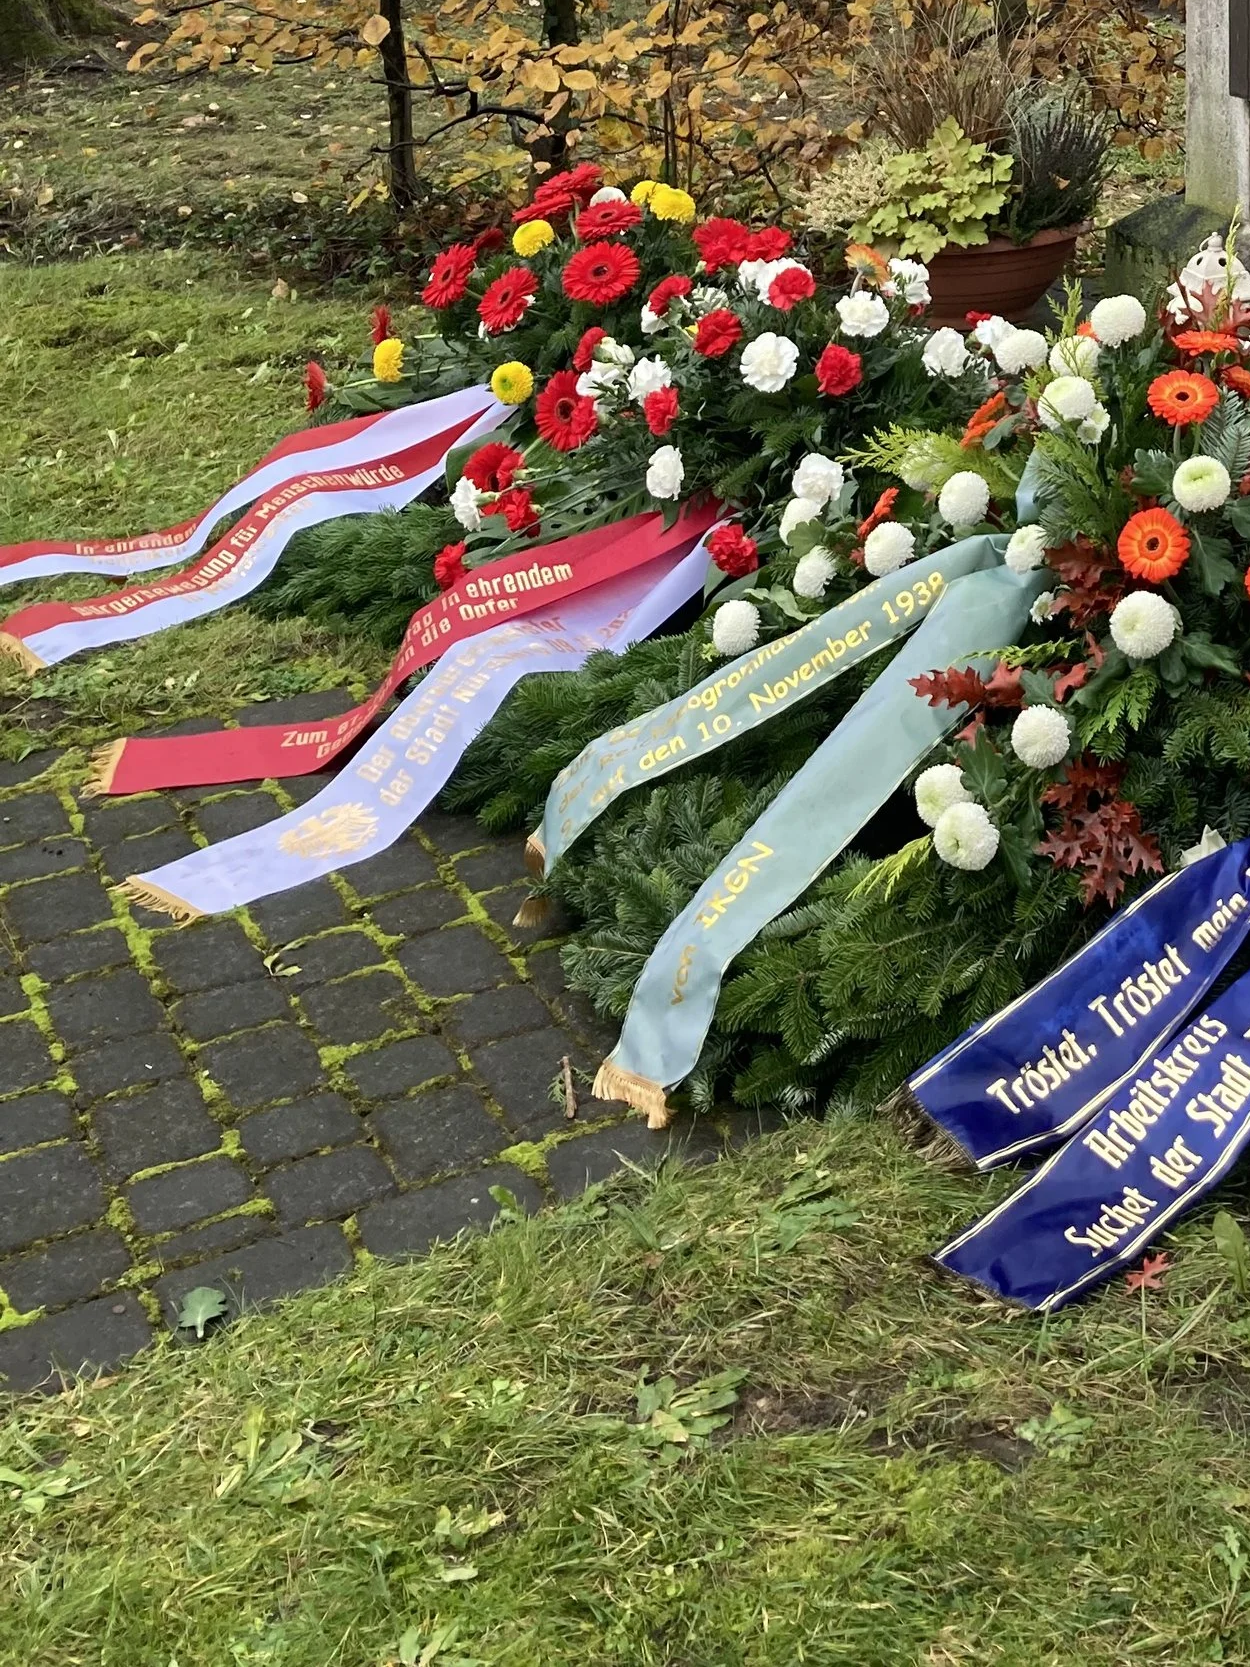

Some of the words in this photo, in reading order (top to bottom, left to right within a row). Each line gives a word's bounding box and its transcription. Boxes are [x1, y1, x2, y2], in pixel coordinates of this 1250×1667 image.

[229, 523, 258, 549] für
[255, 463, 405, 520] Menschenwürde
[281, 730, 328, 747] Zum
[466, 562, 574, 599] ehrendem
[421, 618, 451, 646] die
[458, 597, 519, 621] Opfer
[639, 734, 687, 771] den
[697, 714, 742, 742] 10.
[749, 620, 873, 712] November
[881, 571, 946, 624] 1938
[379, 769, 414, 806] der
[405, 704, 460, 766] Stadt
[671, 944, 697, 1004] von
[1088, 943, 1192, 1037] Tröstet
[1192, 891, 1249, 953] mein
[1083, 1014, 1228, 1170] Arbeitskreis
[1063, 1185, 1158, 1257] Suchet
[1150, 1135, 1204, 1191] der
